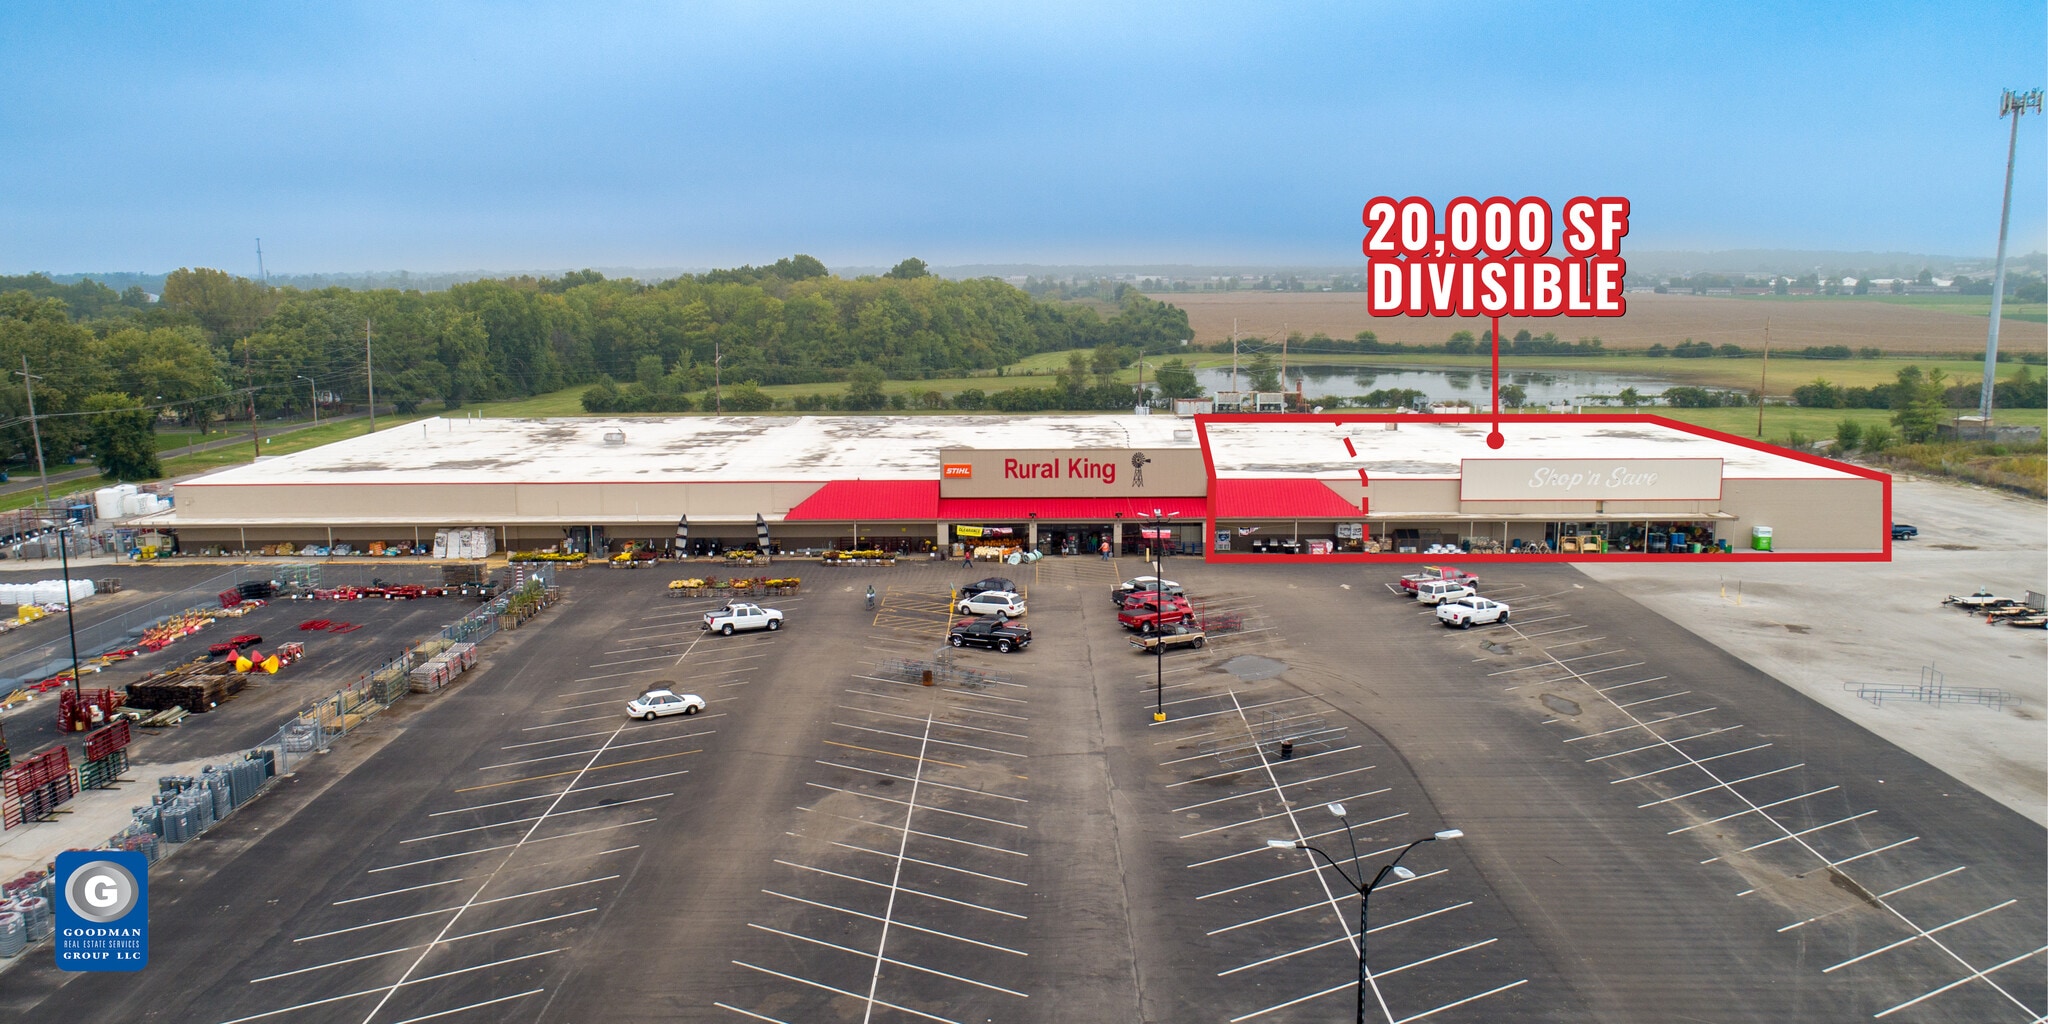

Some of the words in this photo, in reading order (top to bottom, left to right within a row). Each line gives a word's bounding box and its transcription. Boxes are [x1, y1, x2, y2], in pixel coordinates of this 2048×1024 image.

[946, 467, 970, 475] STIHL
[1004, 458, 1059, 479] Rural
[1068, 458, 1116, 485] King
[1605, 466, 1659, 488] Save
